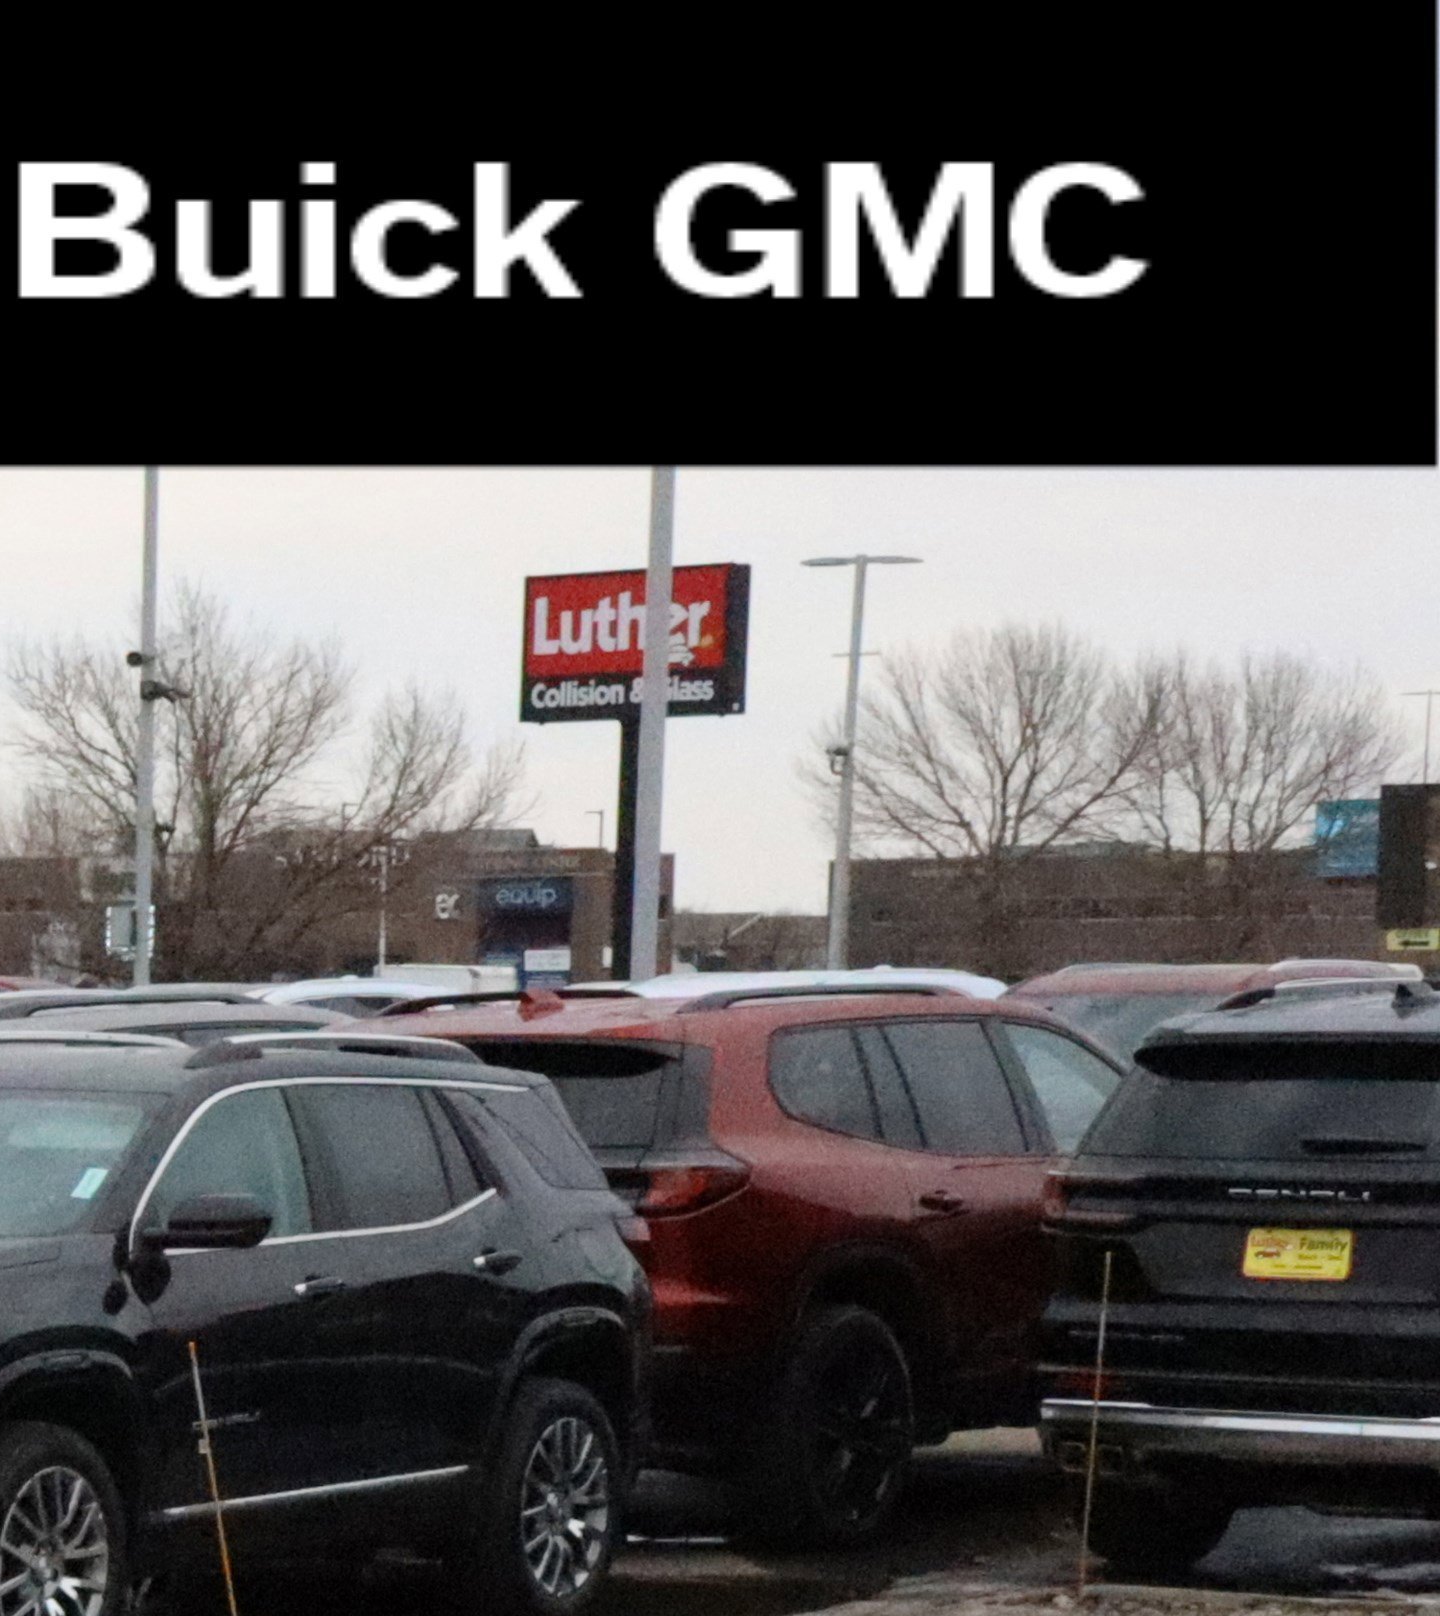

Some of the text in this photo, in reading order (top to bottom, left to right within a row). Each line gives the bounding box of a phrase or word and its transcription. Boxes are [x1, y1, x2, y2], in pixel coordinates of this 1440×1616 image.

[531, 679, 625, 709] Collision
[495, 883, 558, 908] equip
[1299, 1236, 1348, 1254] Family
